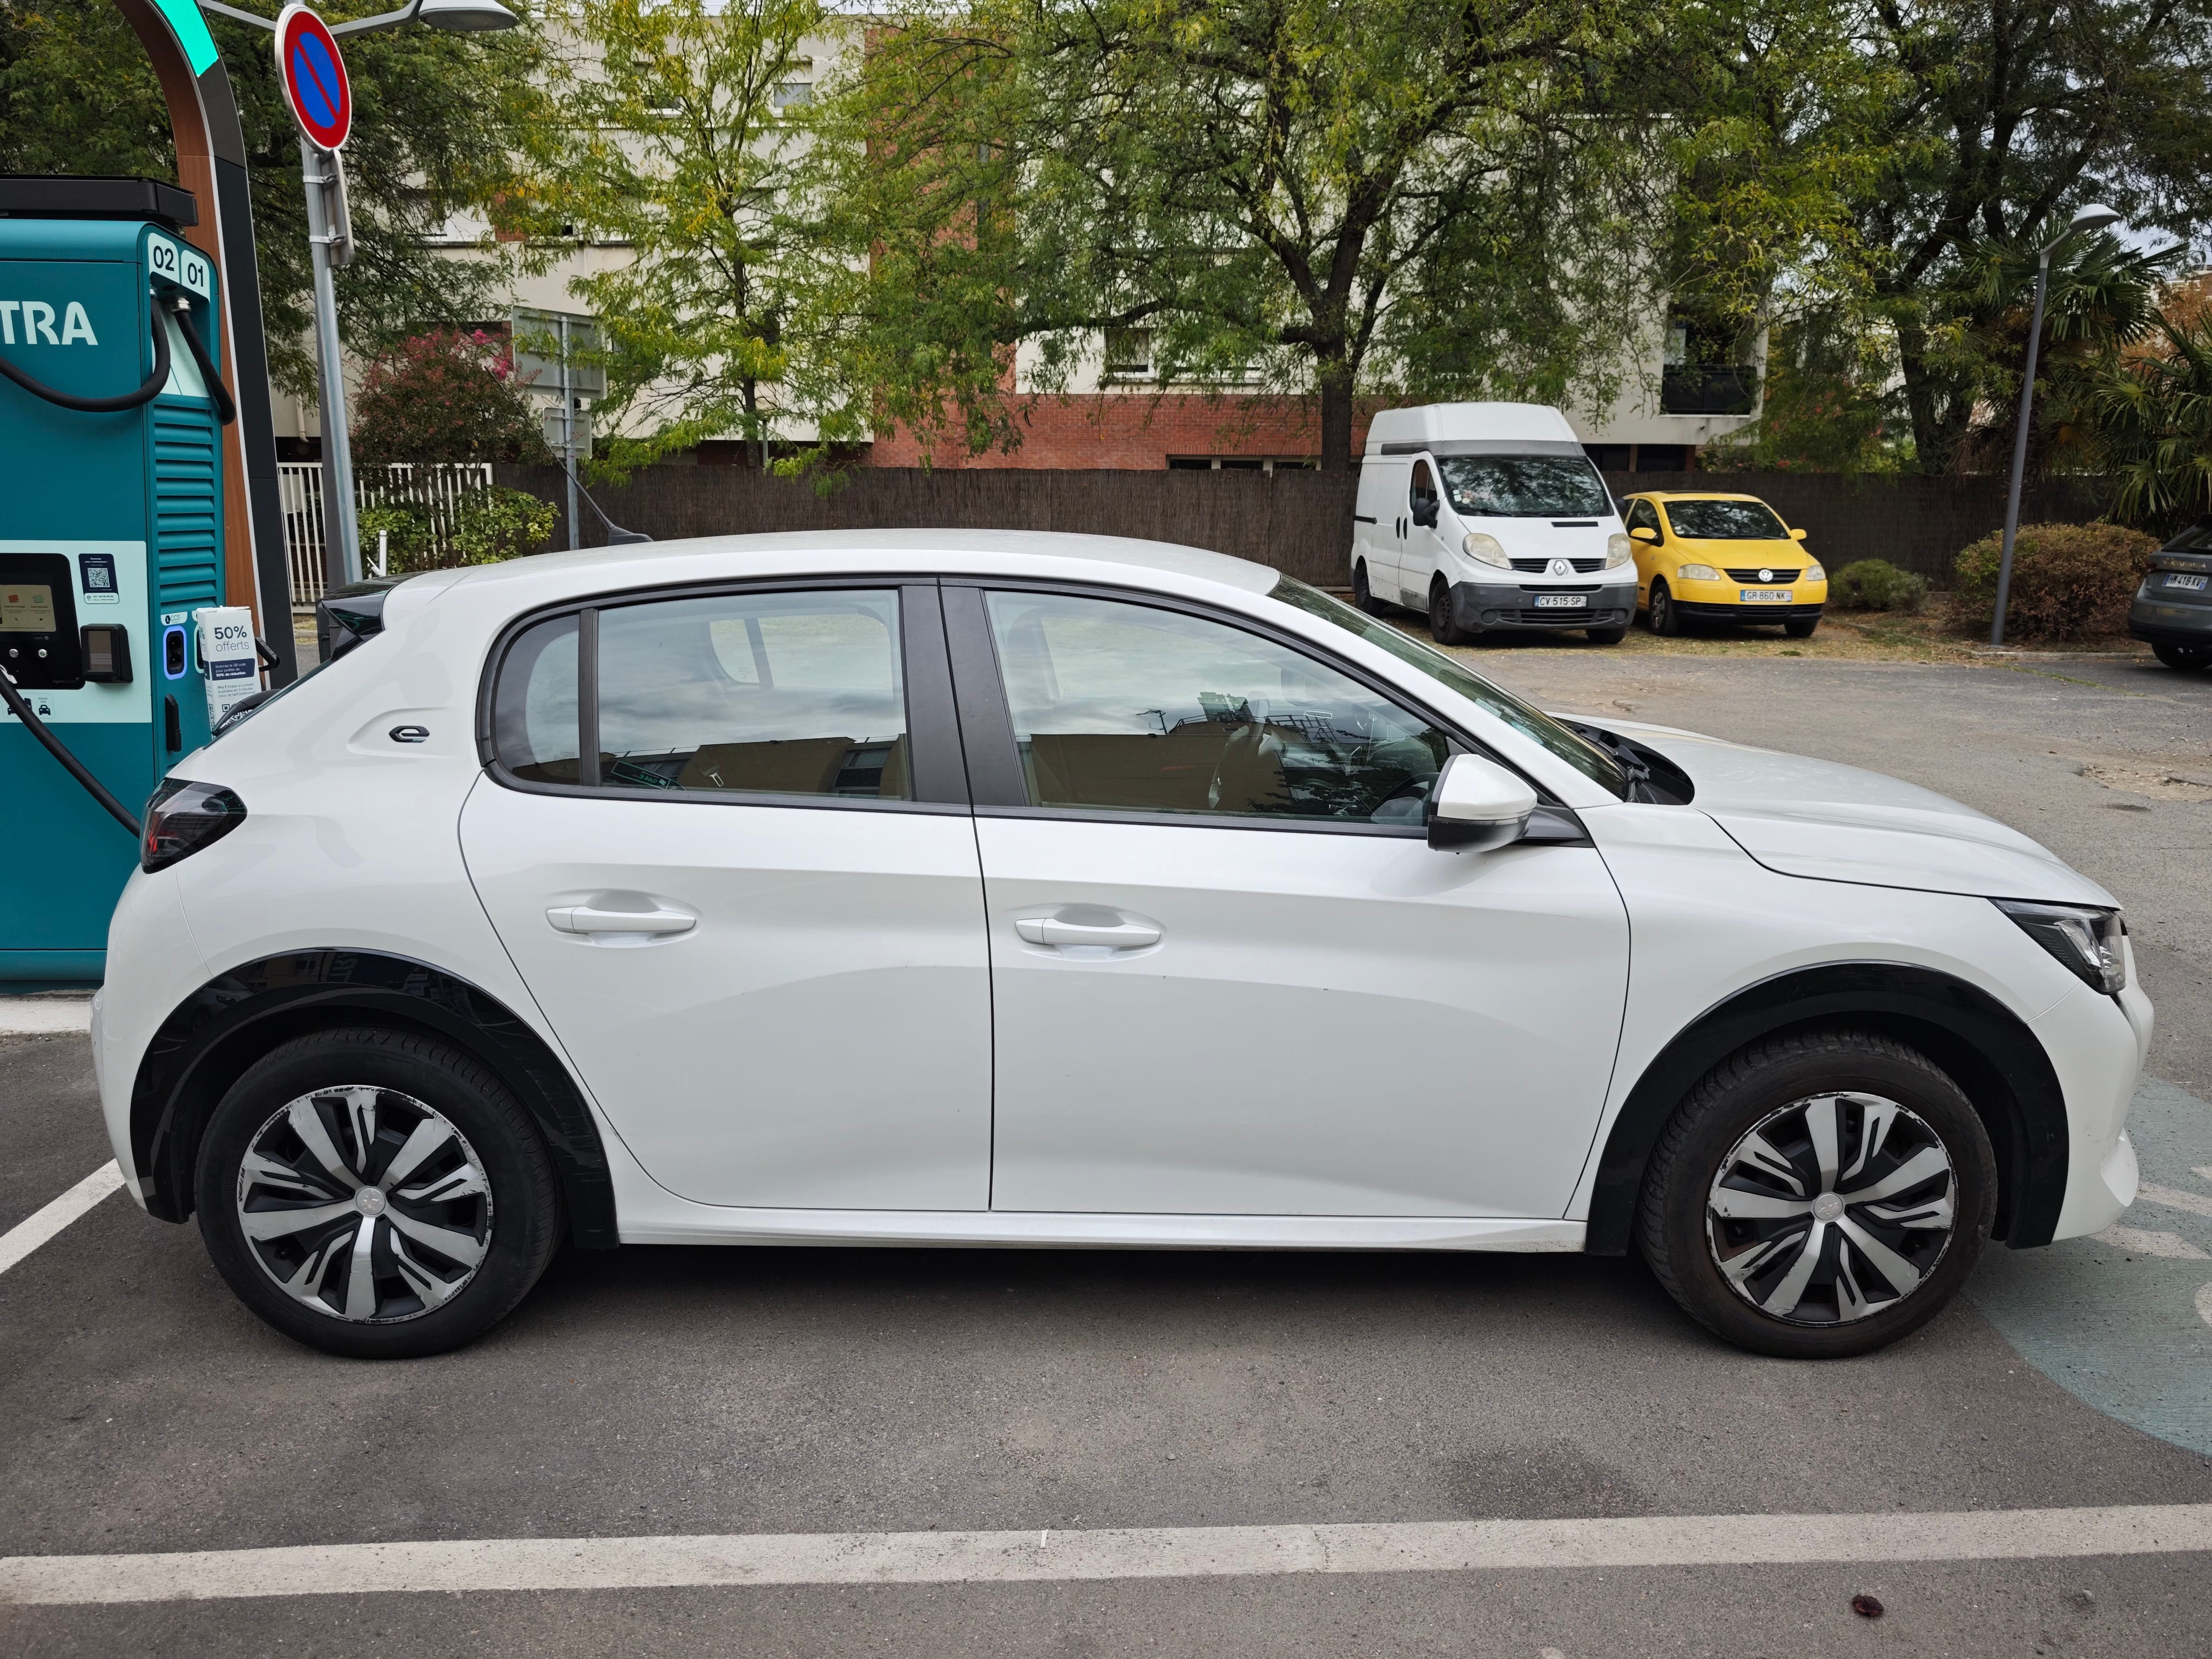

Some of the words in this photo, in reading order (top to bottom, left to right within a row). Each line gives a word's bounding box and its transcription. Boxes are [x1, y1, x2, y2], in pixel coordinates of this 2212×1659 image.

[153, 245, 174, 272] 02
[187, 262, 204, 287] 01
[0, 301, 99, 346] TRA
[214, 625, 247, 639] 50%
[215, 640, 249, 652] offerts
